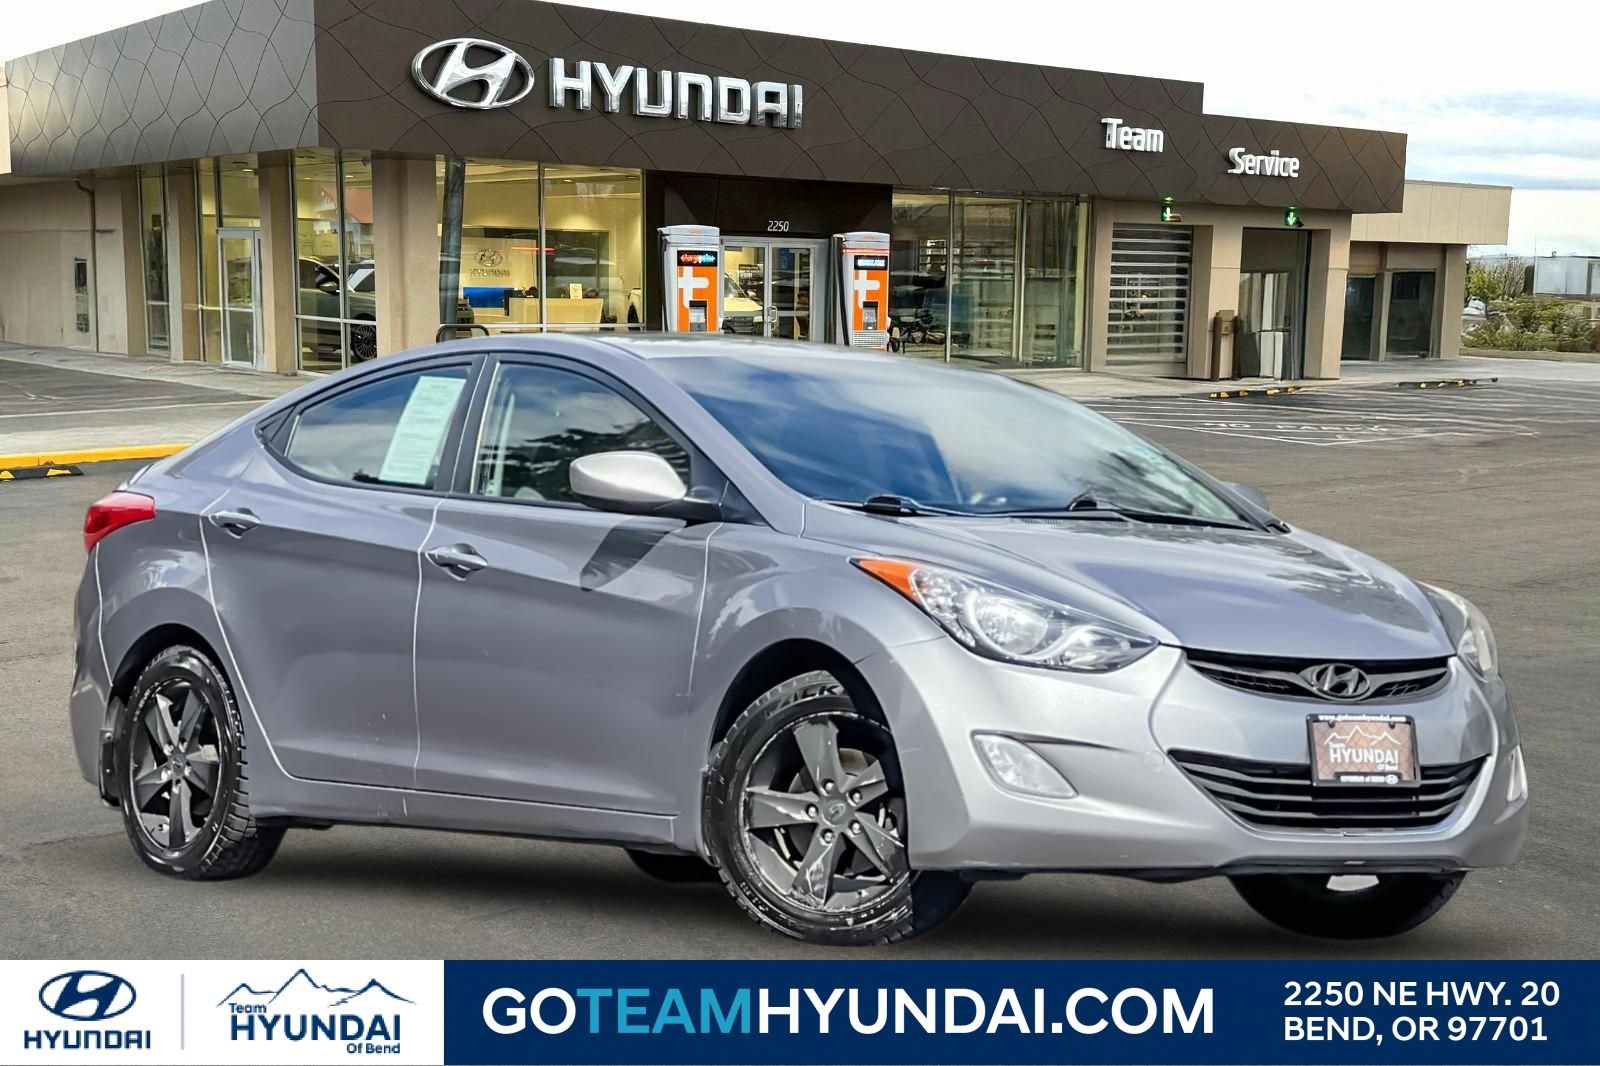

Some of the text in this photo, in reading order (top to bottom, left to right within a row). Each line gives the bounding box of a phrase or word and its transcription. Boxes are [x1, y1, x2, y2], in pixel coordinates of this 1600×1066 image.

[549, 57, 803, 129] HYUNDAI
[1101, 117, 1164, 152] Team
[1227, 147, 1300, 177] Service
[767, 220, 790, 232] 2250
[1329, 748, 1399, 764] HYUNDAI
